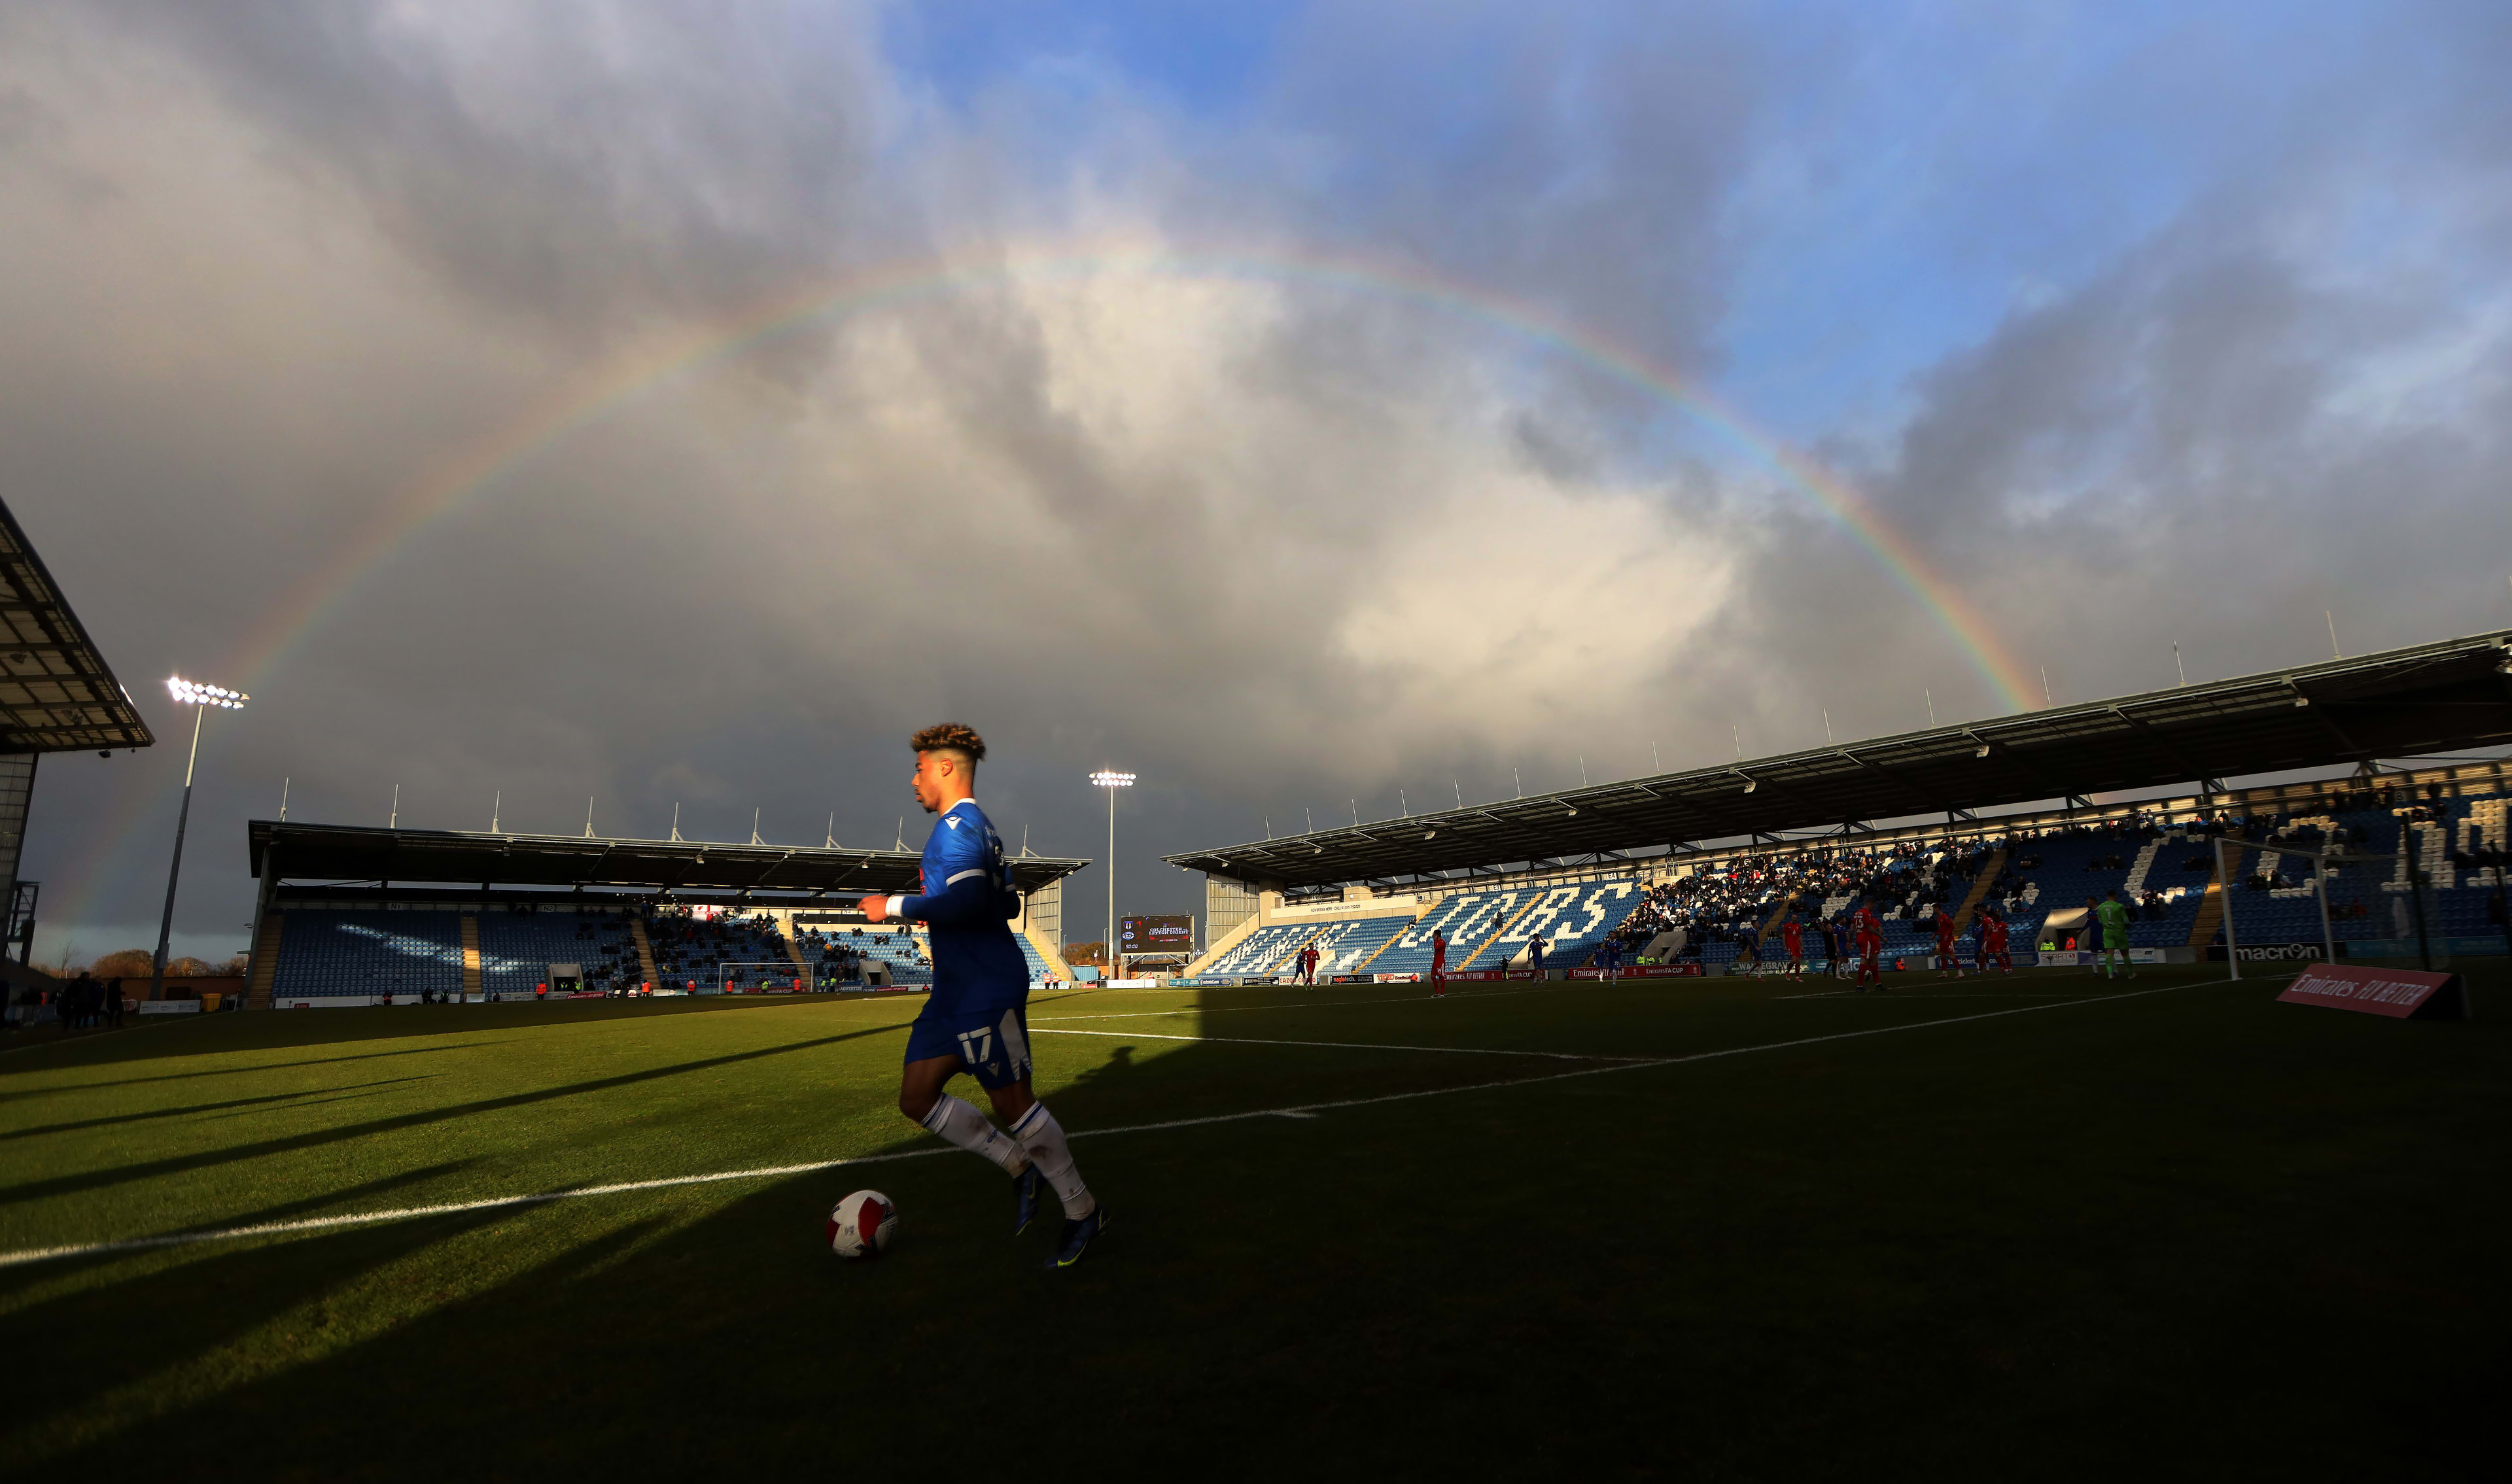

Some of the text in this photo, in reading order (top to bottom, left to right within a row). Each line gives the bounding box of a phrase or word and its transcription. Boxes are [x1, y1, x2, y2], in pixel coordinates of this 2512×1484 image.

[2235, 943, 2322, 960] macron
[1444, 972, 1465, 980] Emirates
[1573, 969, 1599, 977] Emirates
[2292, 975, 2432, 1006] Emirates FLY BETTER
[957, 1026, 992, 1065] 17
